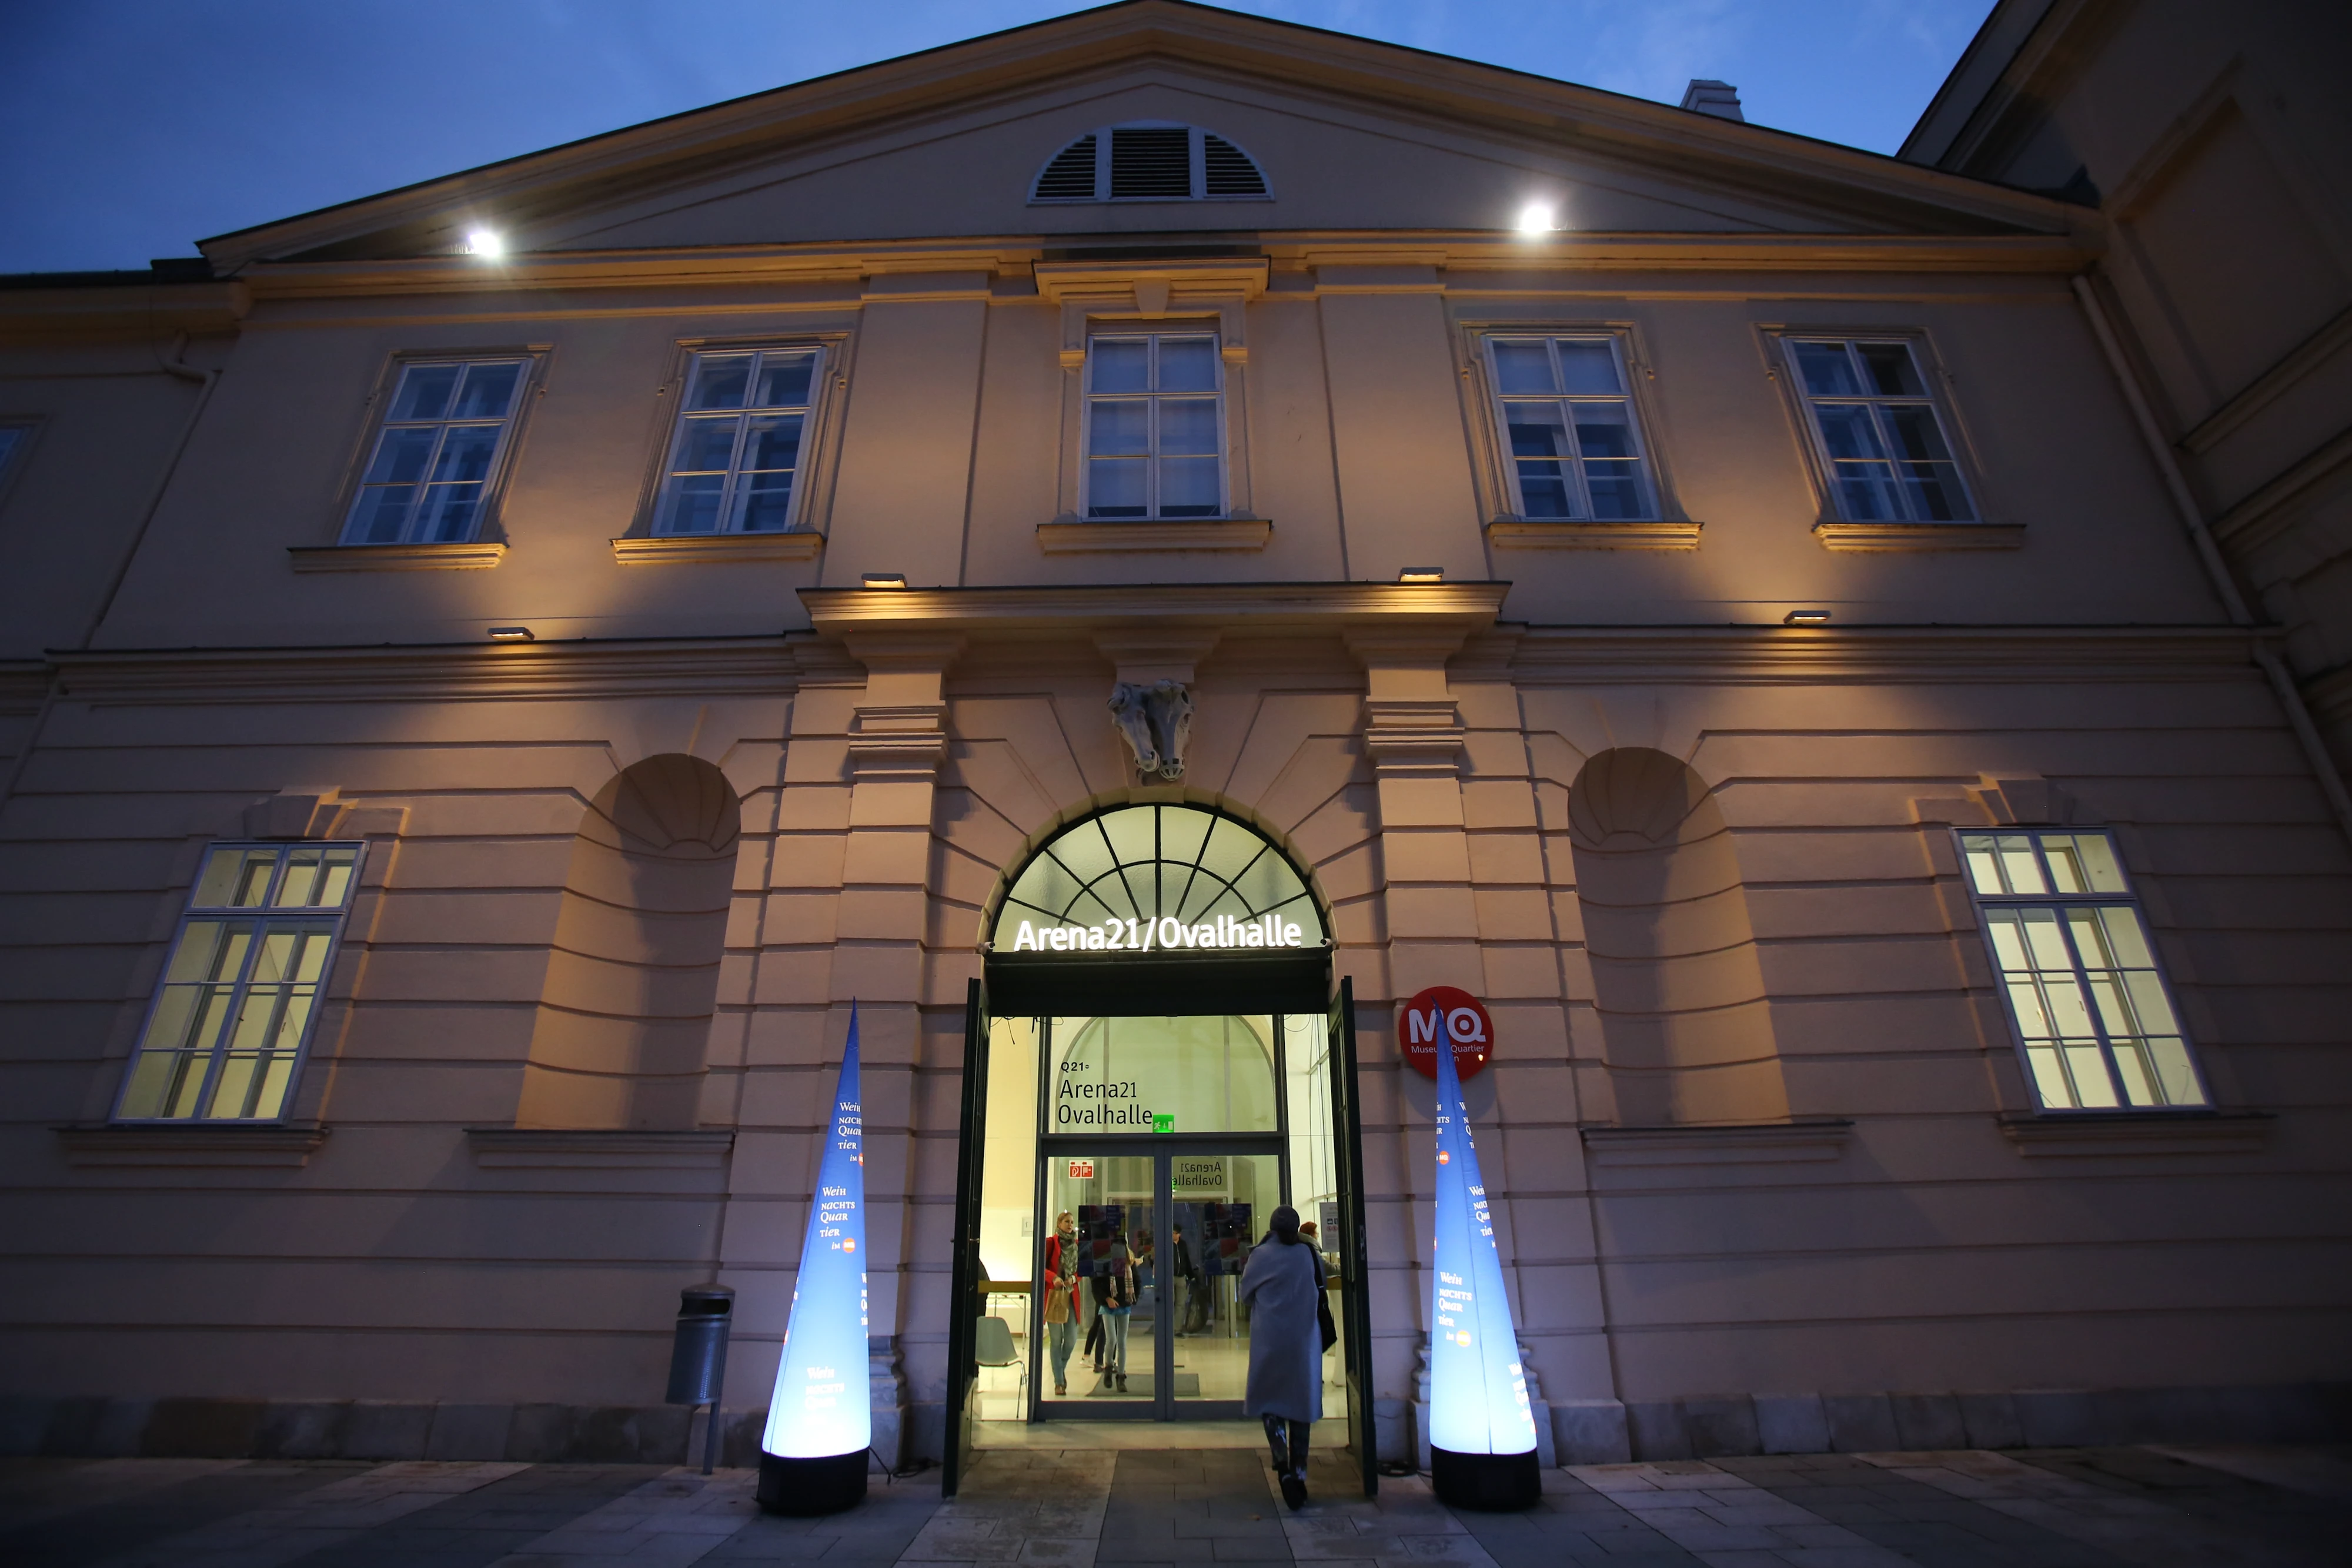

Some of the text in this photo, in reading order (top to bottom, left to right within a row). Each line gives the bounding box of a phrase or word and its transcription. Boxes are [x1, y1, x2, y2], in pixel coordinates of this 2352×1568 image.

[1013, 914, 1302, 952] Arena21/Ovalhalle
[1408, 1007, 1486, 1044] MQ
[1060, 1079, 1137, 1098] Arena21
[1058, 1104, 1152, 1124] Ovalhalle
